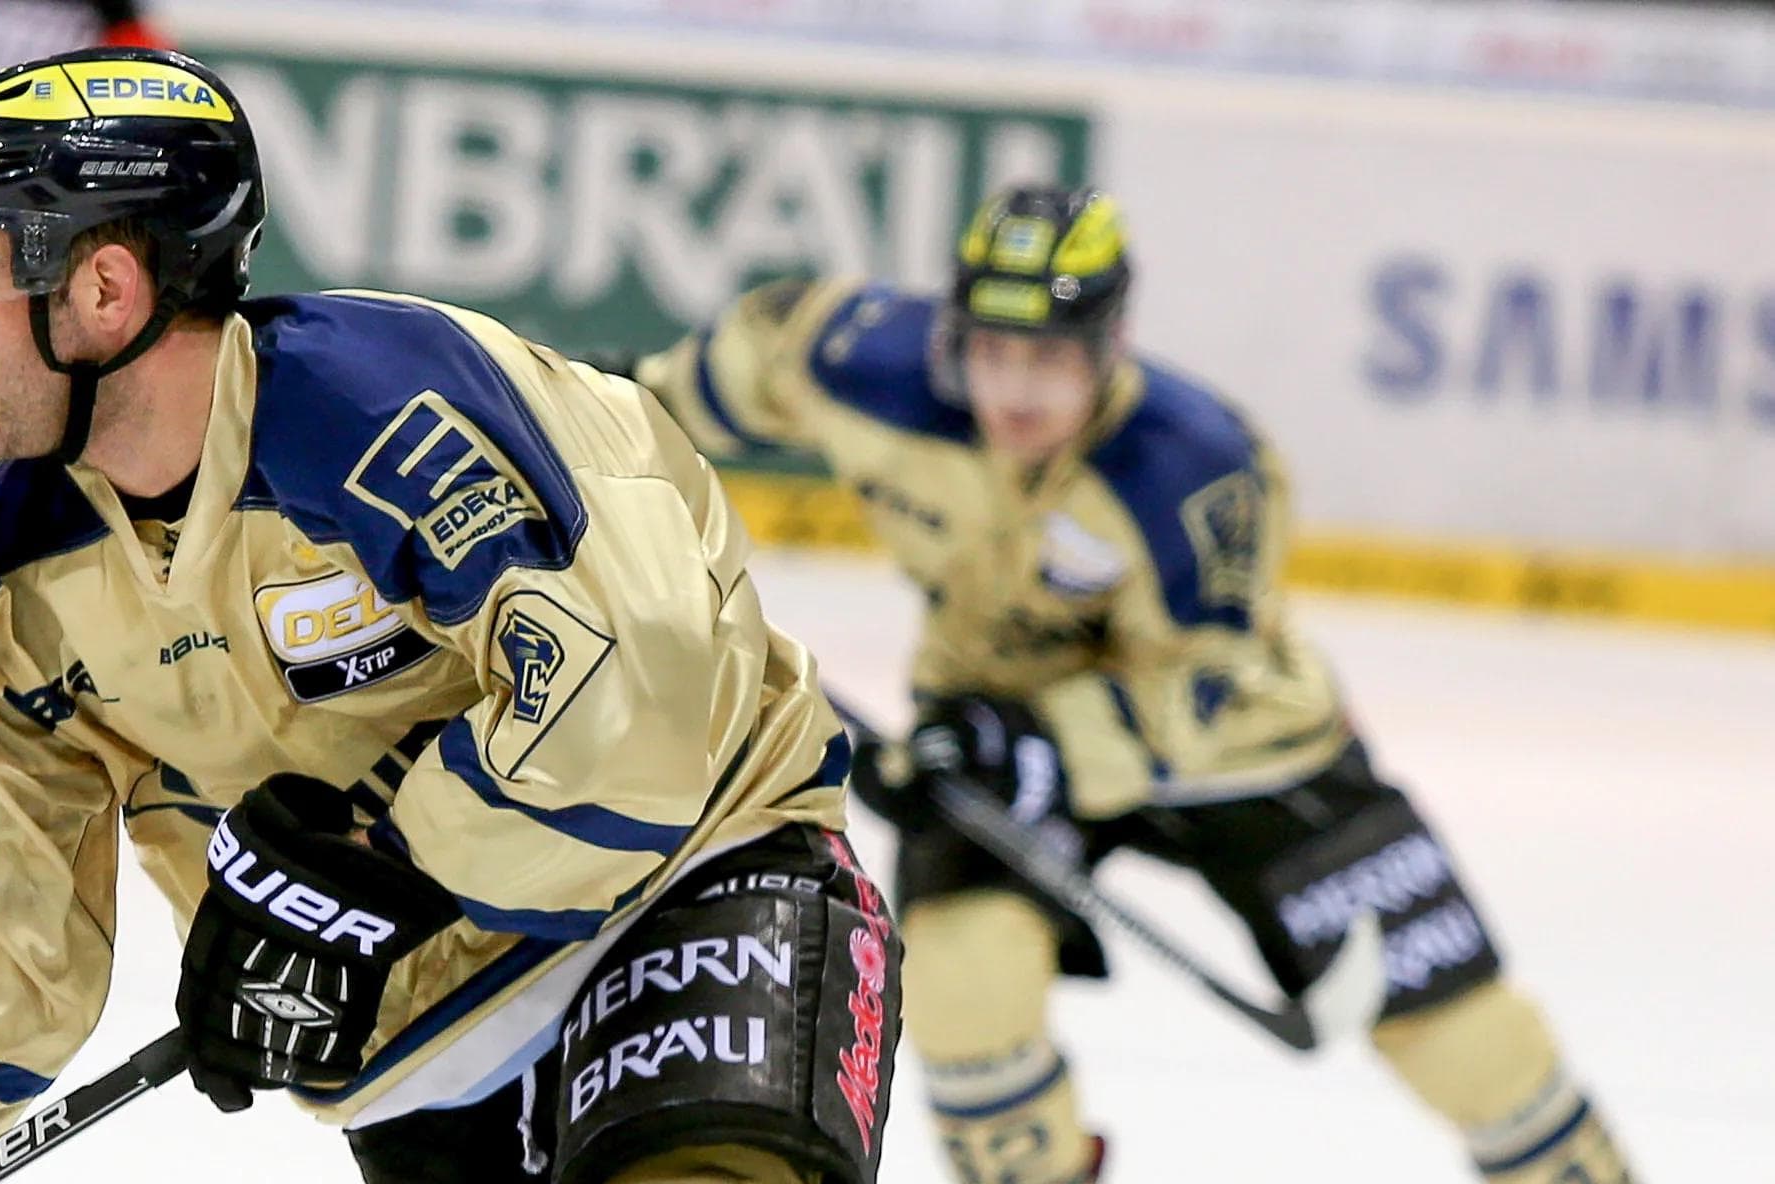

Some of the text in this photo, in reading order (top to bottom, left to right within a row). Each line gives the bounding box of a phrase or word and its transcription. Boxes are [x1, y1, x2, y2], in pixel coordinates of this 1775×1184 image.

[86, 78, 216, 108] EDEKA
[79, 161, 169, 176] BAUER
[430, 480, 525, 543] EDEKA
[283, 586, 394, 648] DEL
[208, 806, 396, 956] AUER
[563, 935, 792, 1064] HERRN
[569, 1016, 766, 1124] BRÄU
